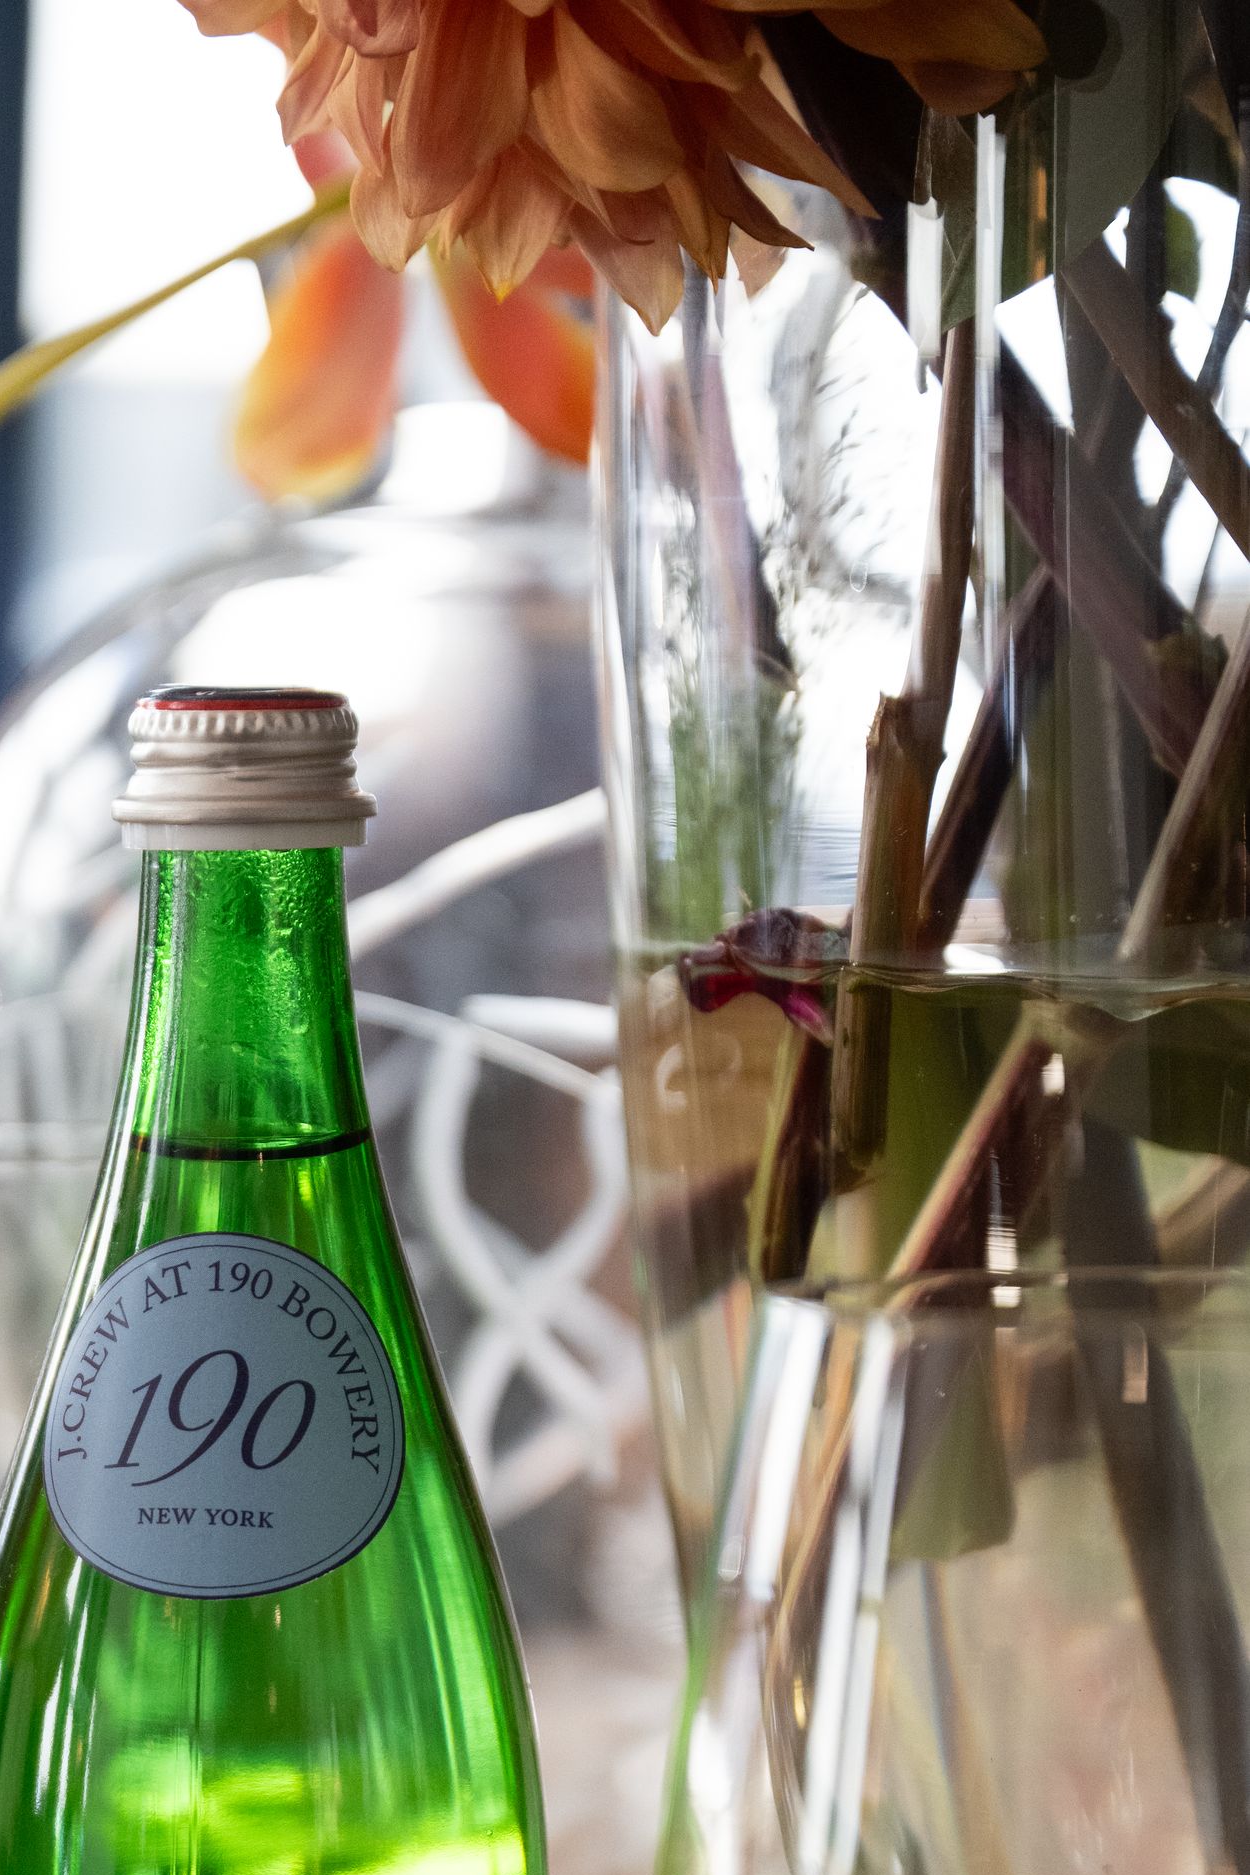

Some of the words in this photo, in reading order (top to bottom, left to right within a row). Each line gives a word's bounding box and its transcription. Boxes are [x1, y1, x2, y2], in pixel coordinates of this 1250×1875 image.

[57, 1297, 131, 1462] J.CREW
[142, 1260, 192, 1314] AT
[208, 1260, 274, 1301] 190
[278, 1281, 381, 1475] BOWERY
[104, 1349, 317, 1487] 190
[137, 1507, 198, 1525] NEW
[204, 1508, 275, 1529] YORK
